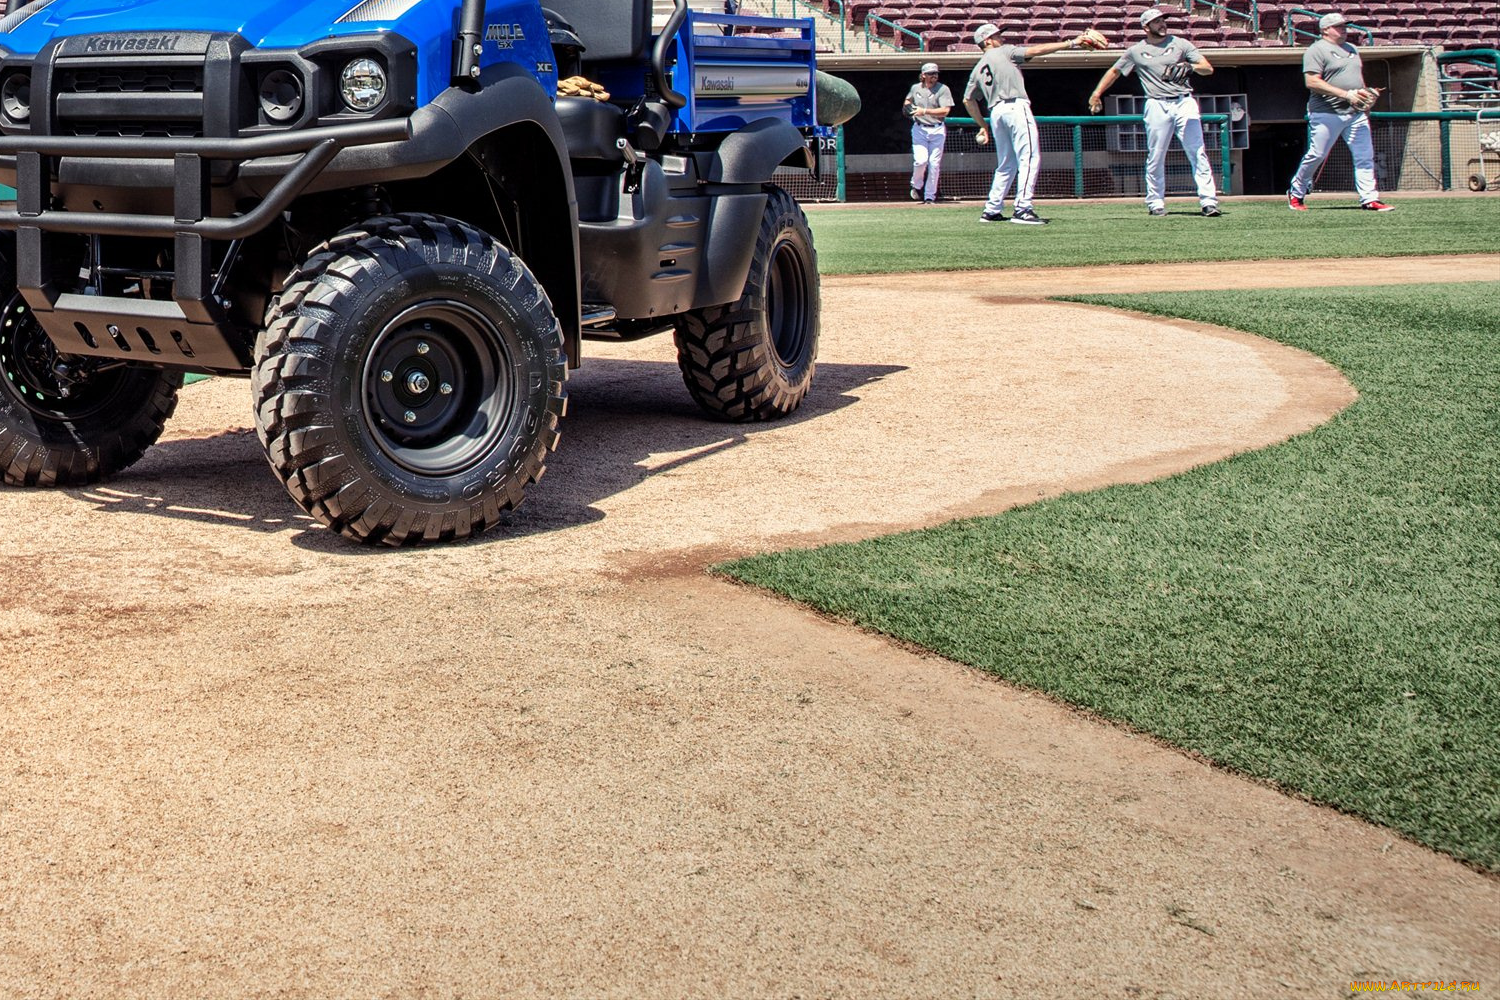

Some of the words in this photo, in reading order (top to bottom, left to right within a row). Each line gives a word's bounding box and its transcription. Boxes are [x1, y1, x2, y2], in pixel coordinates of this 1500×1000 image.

[485, 23, 526, 42] MULE
[83, 35, 181, 53] Kawasaki
[498, 41, 514, 50] SX
[537, 63, 553, 72] XC
[980, 64, 994, 87] 3
[701, 76, 735, 91] Kawasaki
